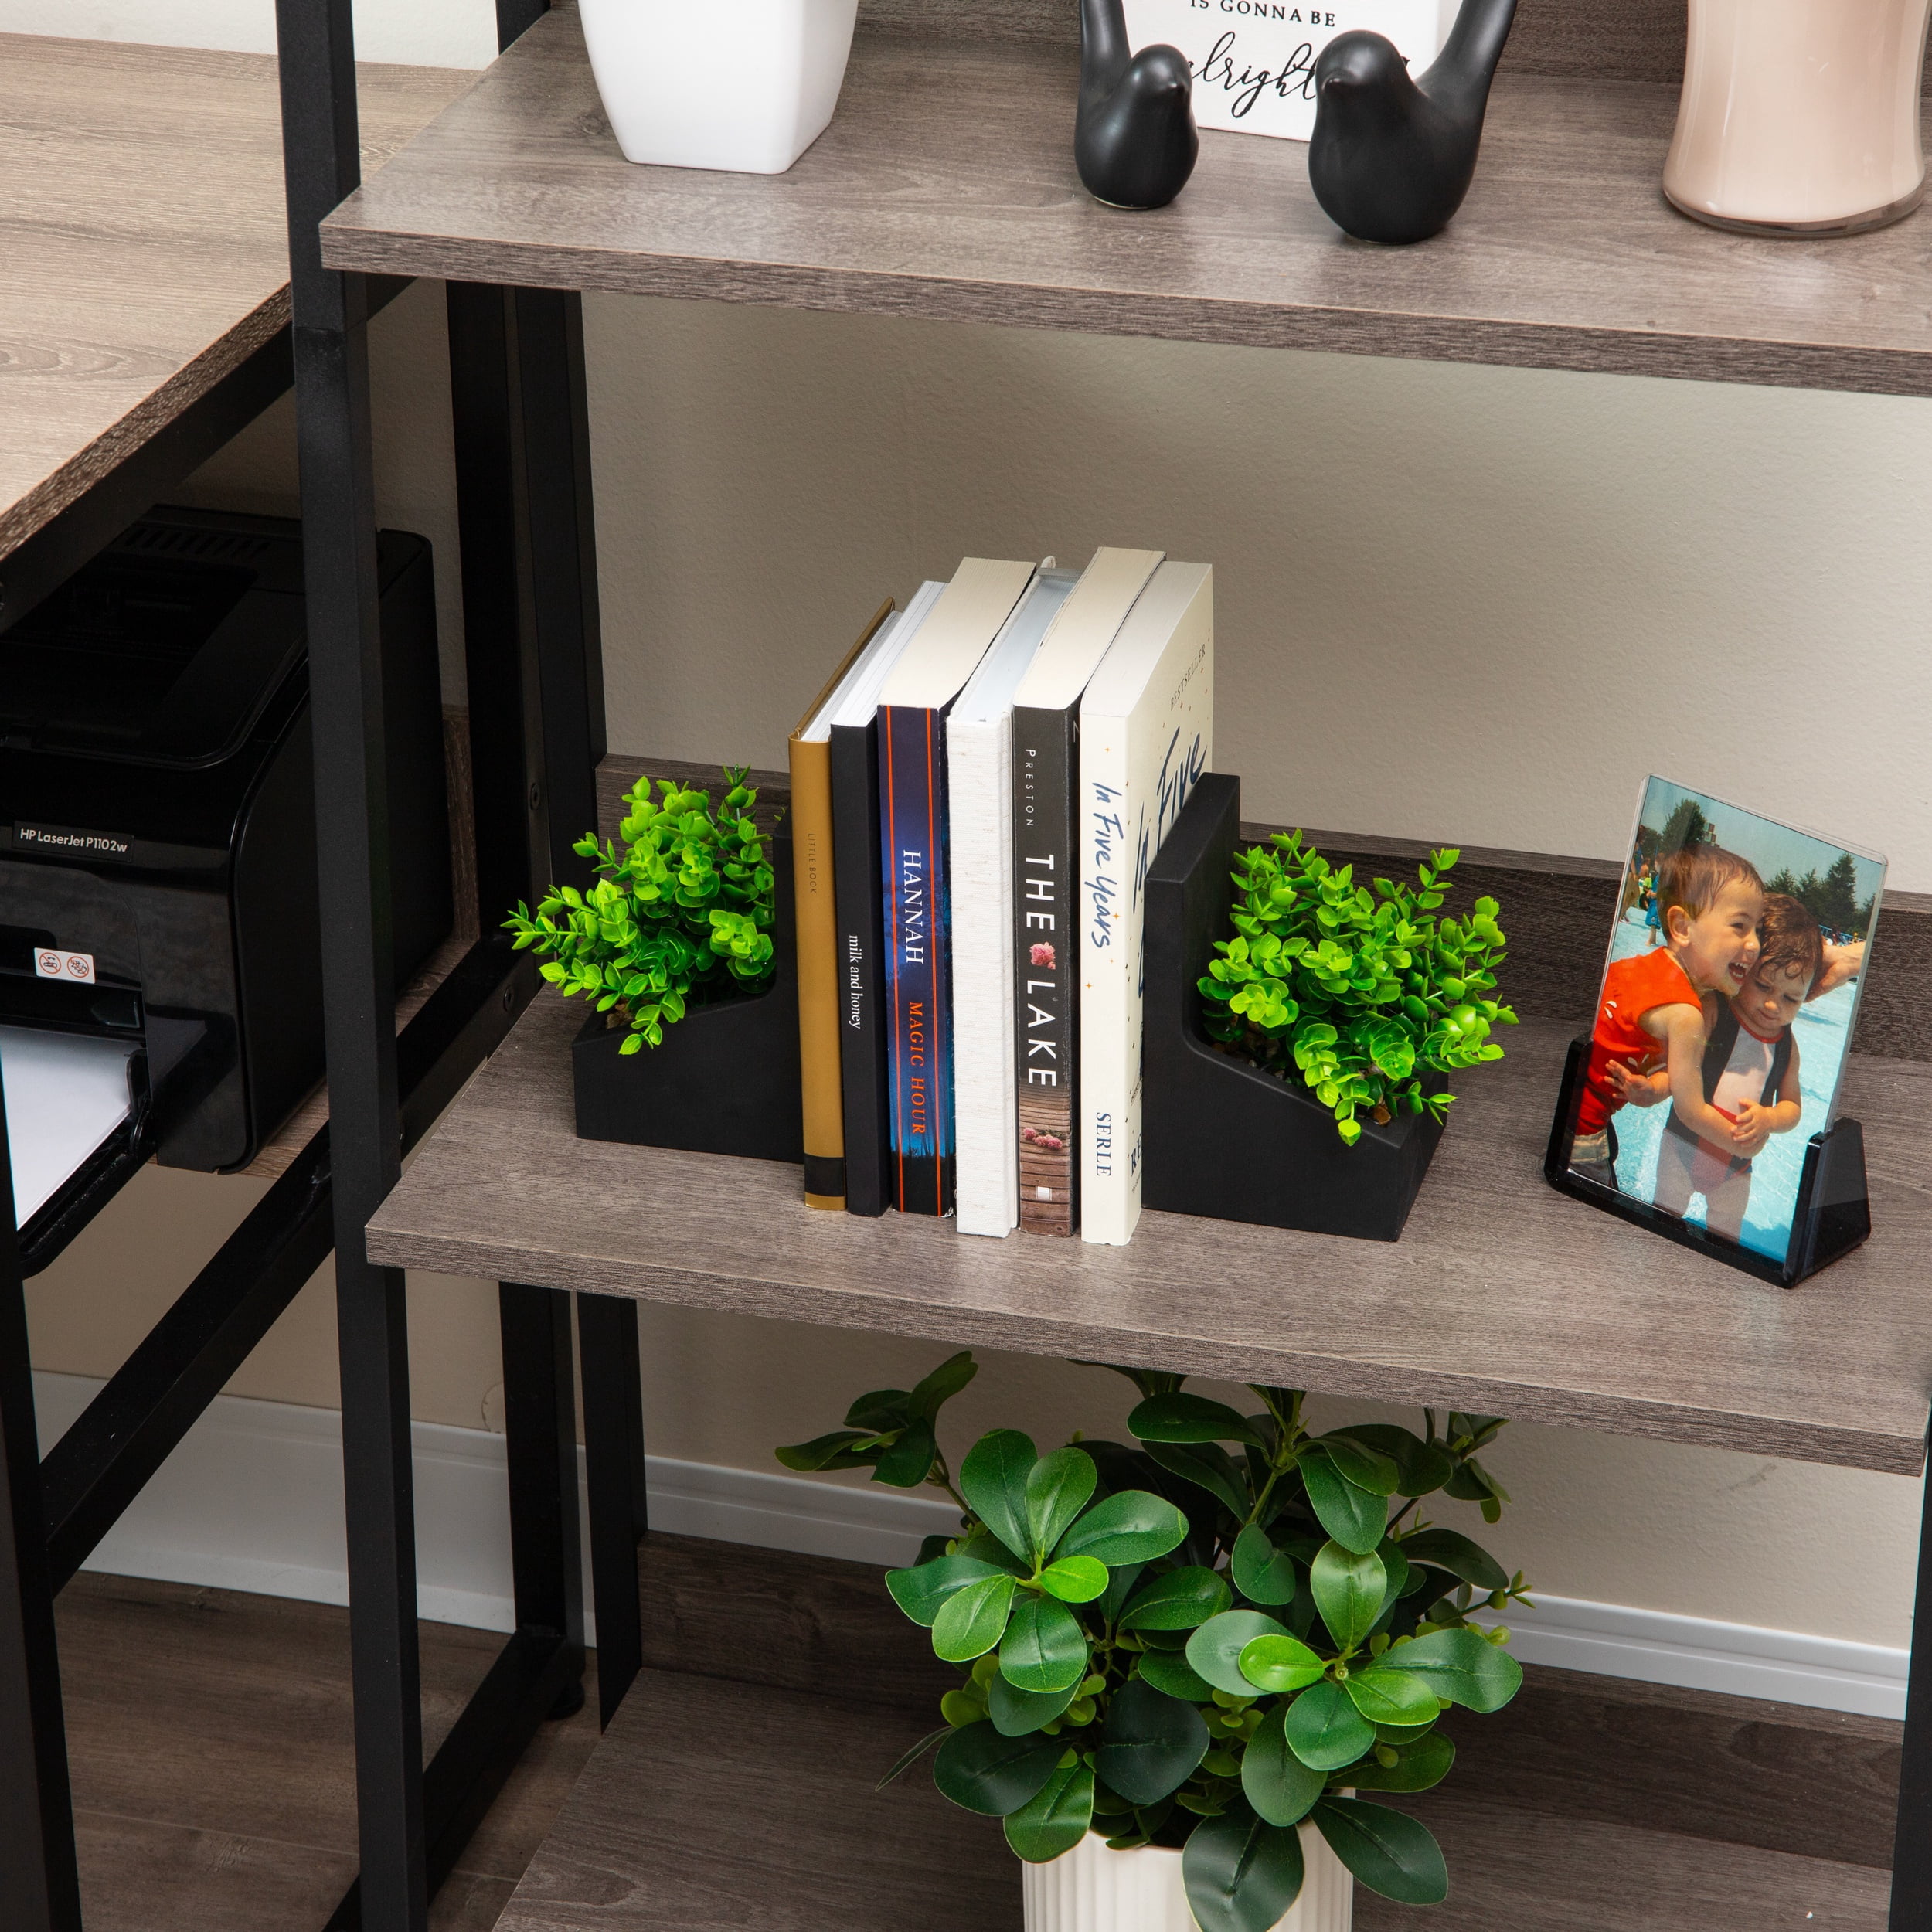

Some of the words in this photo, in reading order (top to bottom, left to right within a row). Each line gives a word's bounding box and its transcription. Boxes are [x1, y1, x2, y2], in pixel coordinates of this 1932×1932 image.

[1220, 0, 1302, 22] GONNA
[1311, 11, 1335, 27] BE
[1188, 32, 1316, 117] lright
[1170, 643, 1206, 711] BESTSELLER
[1025, 749, 1036, 826] PRESTON
[1093, 782, 1122, 804] In
[20, 828, 36, 840] HP
[38, 831, 84, 847] LaserJet
[87, 837, 128, 852] P1102w
[808, 833, 816, 862] LITTLE
[1093, 813, 1124, 869] Five
[808, 866, 817, 894] BOOK
[903, 849, 924, 964] HANNAH
[1026, 854, 1055, 930] THE
[1084, 876, 1117, 948] Years
[849, 935, 862, 963] milk
[849, 966, 863, 989] and
[848, 992, 863, 1029] honey
[909, 1002, 924, 1066] MAGIC
[1027, 980, 1056, 1087] LAKE
[910, 1077, 927, 1134] HOUR
[1096, 1113, 1112, 1176] SERLE
